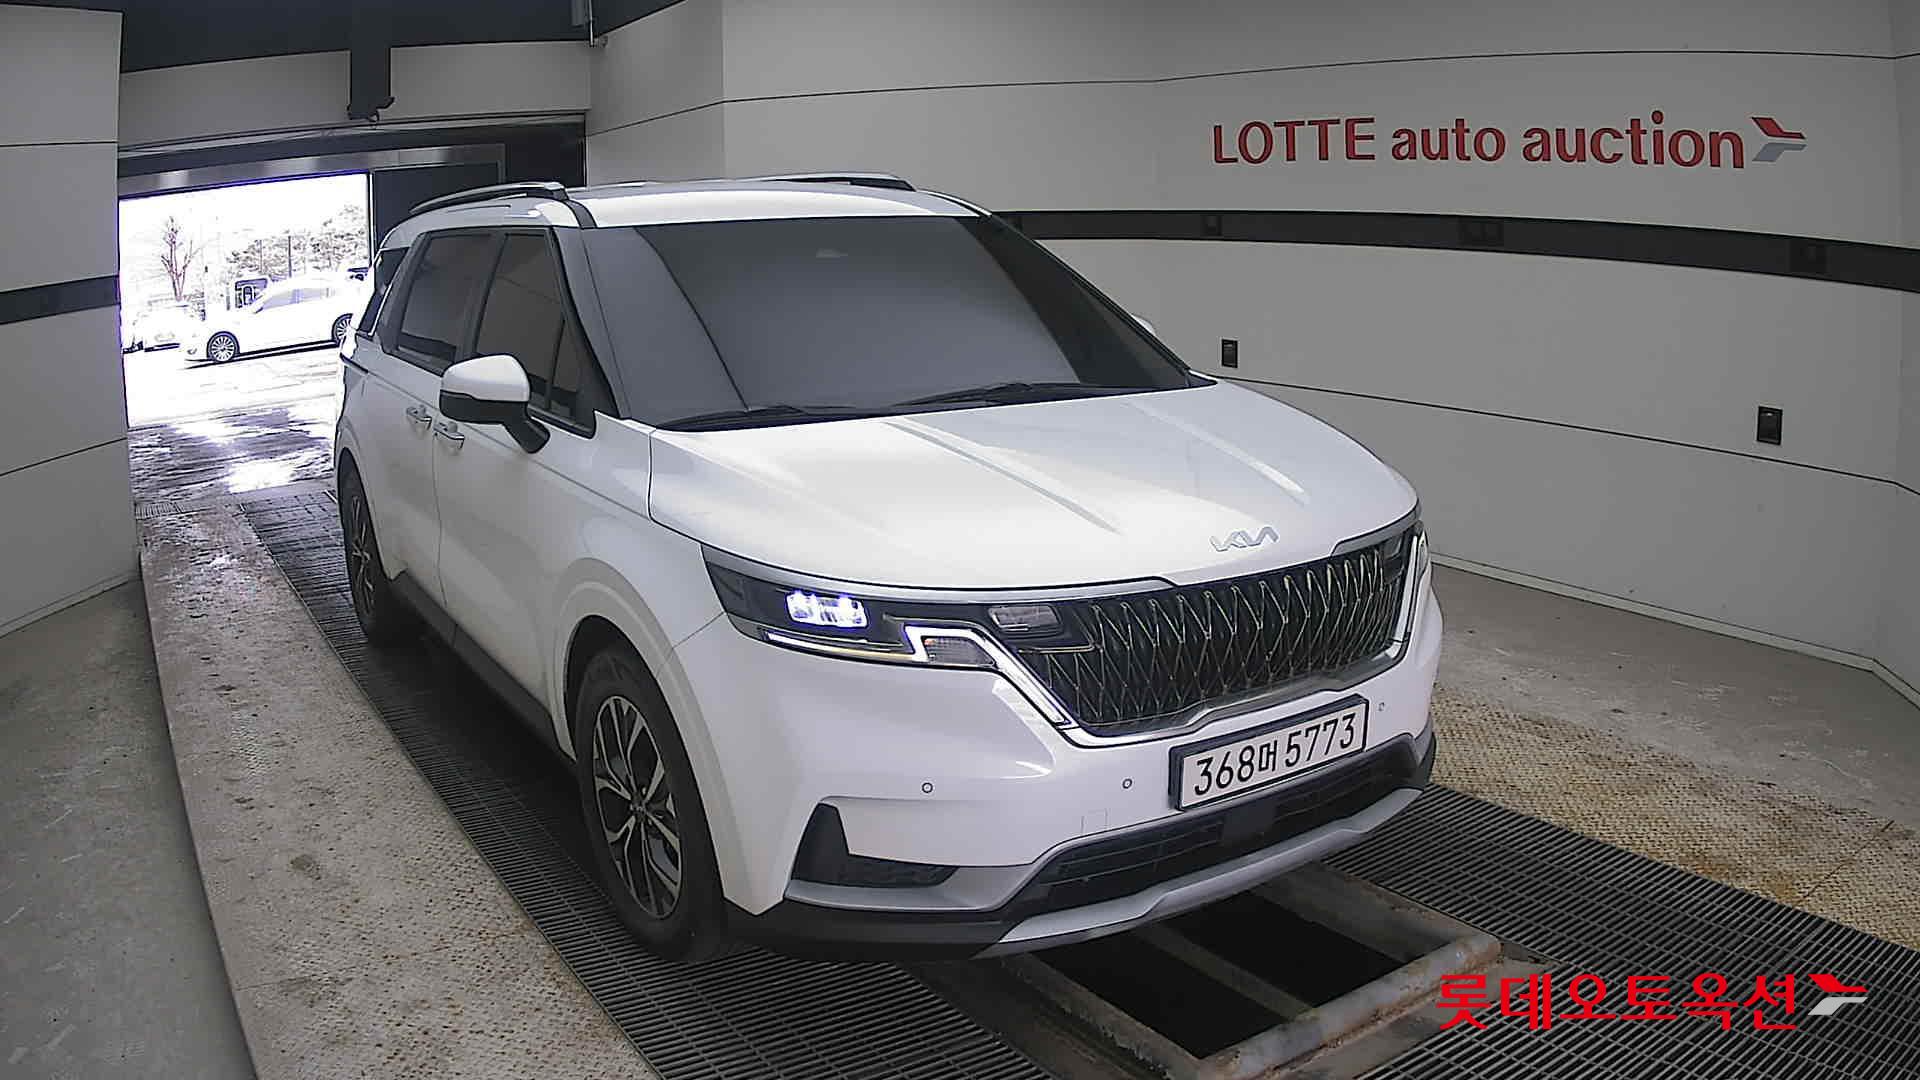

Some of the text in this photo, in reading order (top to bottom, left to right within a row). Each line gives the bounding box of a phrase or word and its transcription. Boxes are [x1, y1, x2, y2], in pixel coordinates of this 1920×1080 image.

[1213, 110, 1745, 169] LOTTE auto auction
[1194, 712, 1356, 795] 368머 5773
